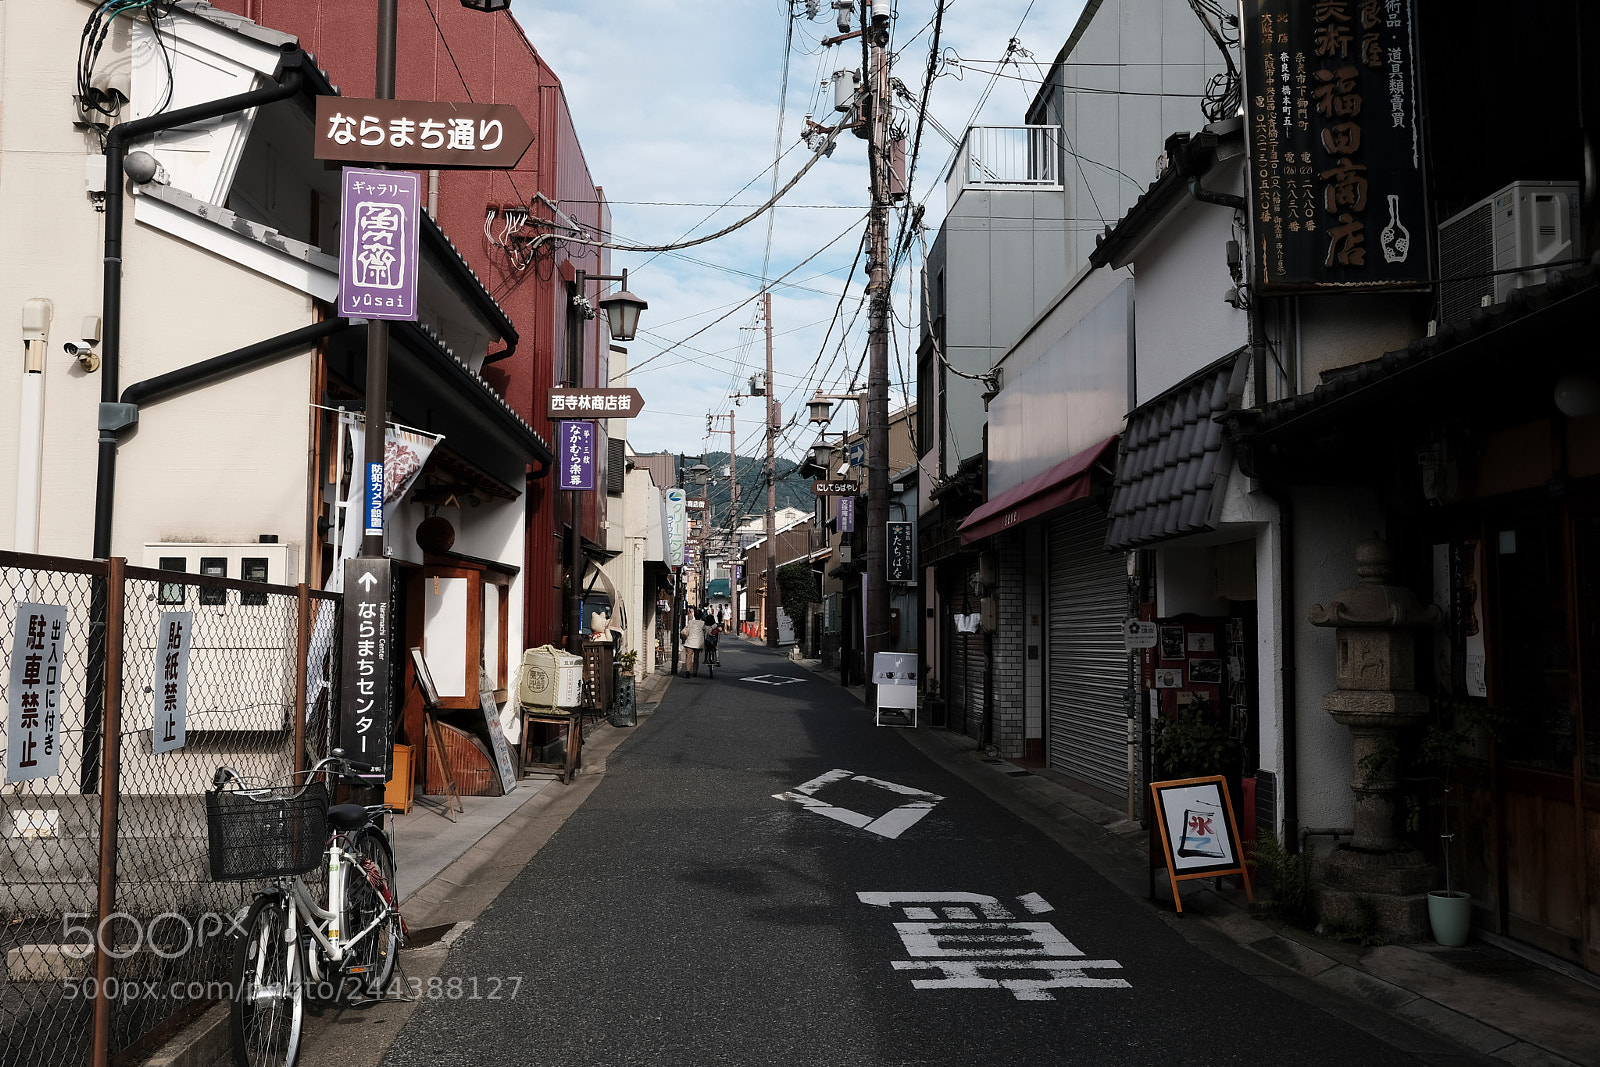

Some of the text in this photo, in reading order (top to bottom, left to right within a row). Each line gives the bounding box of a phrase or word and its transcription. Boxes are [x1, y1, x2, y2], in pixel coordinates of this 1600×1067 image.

[1261, 11, 1274, 44] 大阪店
[327, 112, 503, 151] ならまち通り
[352, 180, 410, 197] ギャラリー
[551, 394, 632, 411] 西寺林商店街
[569, 424, 582, 486] なかむら楽器
[371, 464, 384, 528] 防犯カメラ設置
[816, 483, 858, 492] にしてらばやし
[673, 503, 682, 562] クリーニング
[892, 535, 904, 579] たちばな
[378, 602, 387, 661] Naramachi Center
[19, 614, 47, 768] 駐車禁止
[44, 619, 61, 756] 出入口に付き
[162, 620, 183, 743] 貼紙禁止
[355, 601, 377, 753] ならまちセンター
